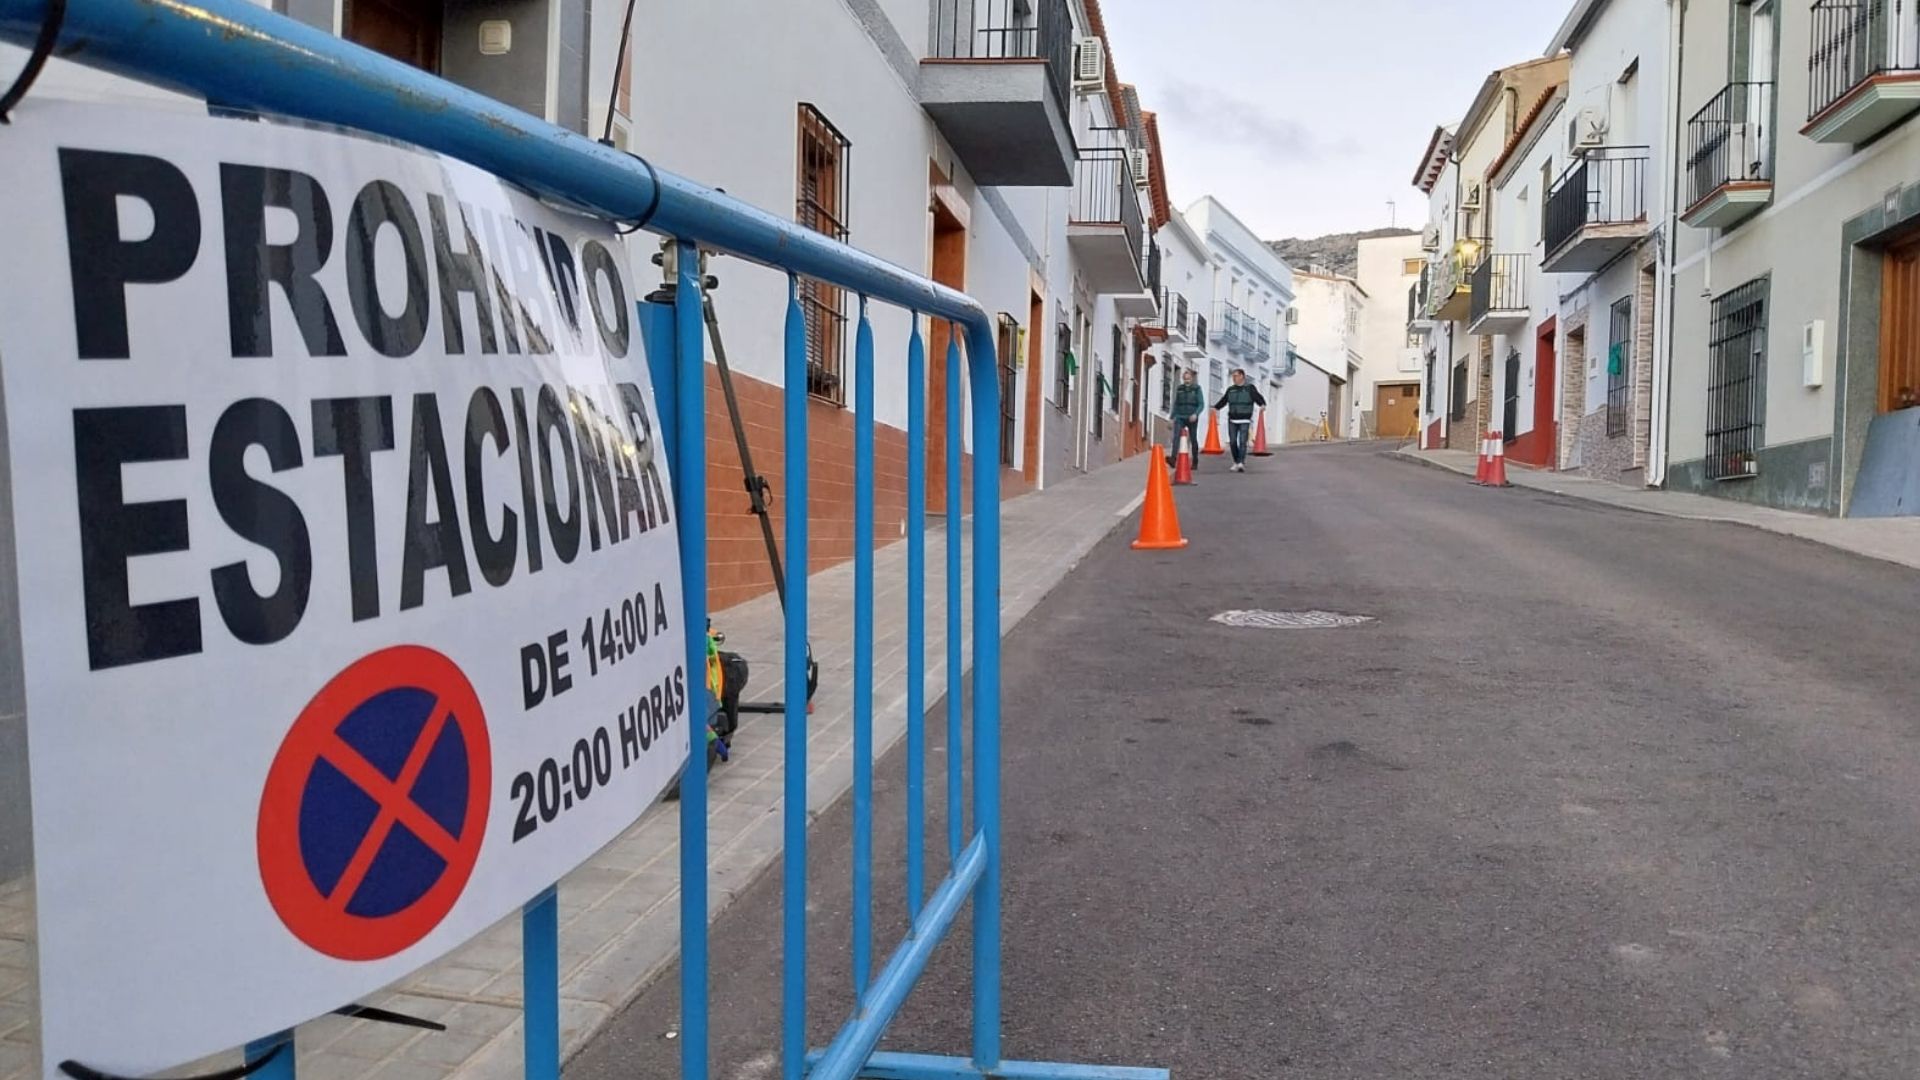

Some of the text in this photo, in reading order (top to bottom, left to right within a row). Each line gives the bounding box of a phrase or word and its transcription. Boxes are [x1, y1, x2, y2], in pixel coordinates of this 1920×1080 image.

[58, 146, 629, 359] PROHIBIDO
[73, 383, 669, 671] ESTACIONAR
[521, 582, 668, 711] DE 14:00 A
[510, 665, 684, 843] 20:00 HORAS
